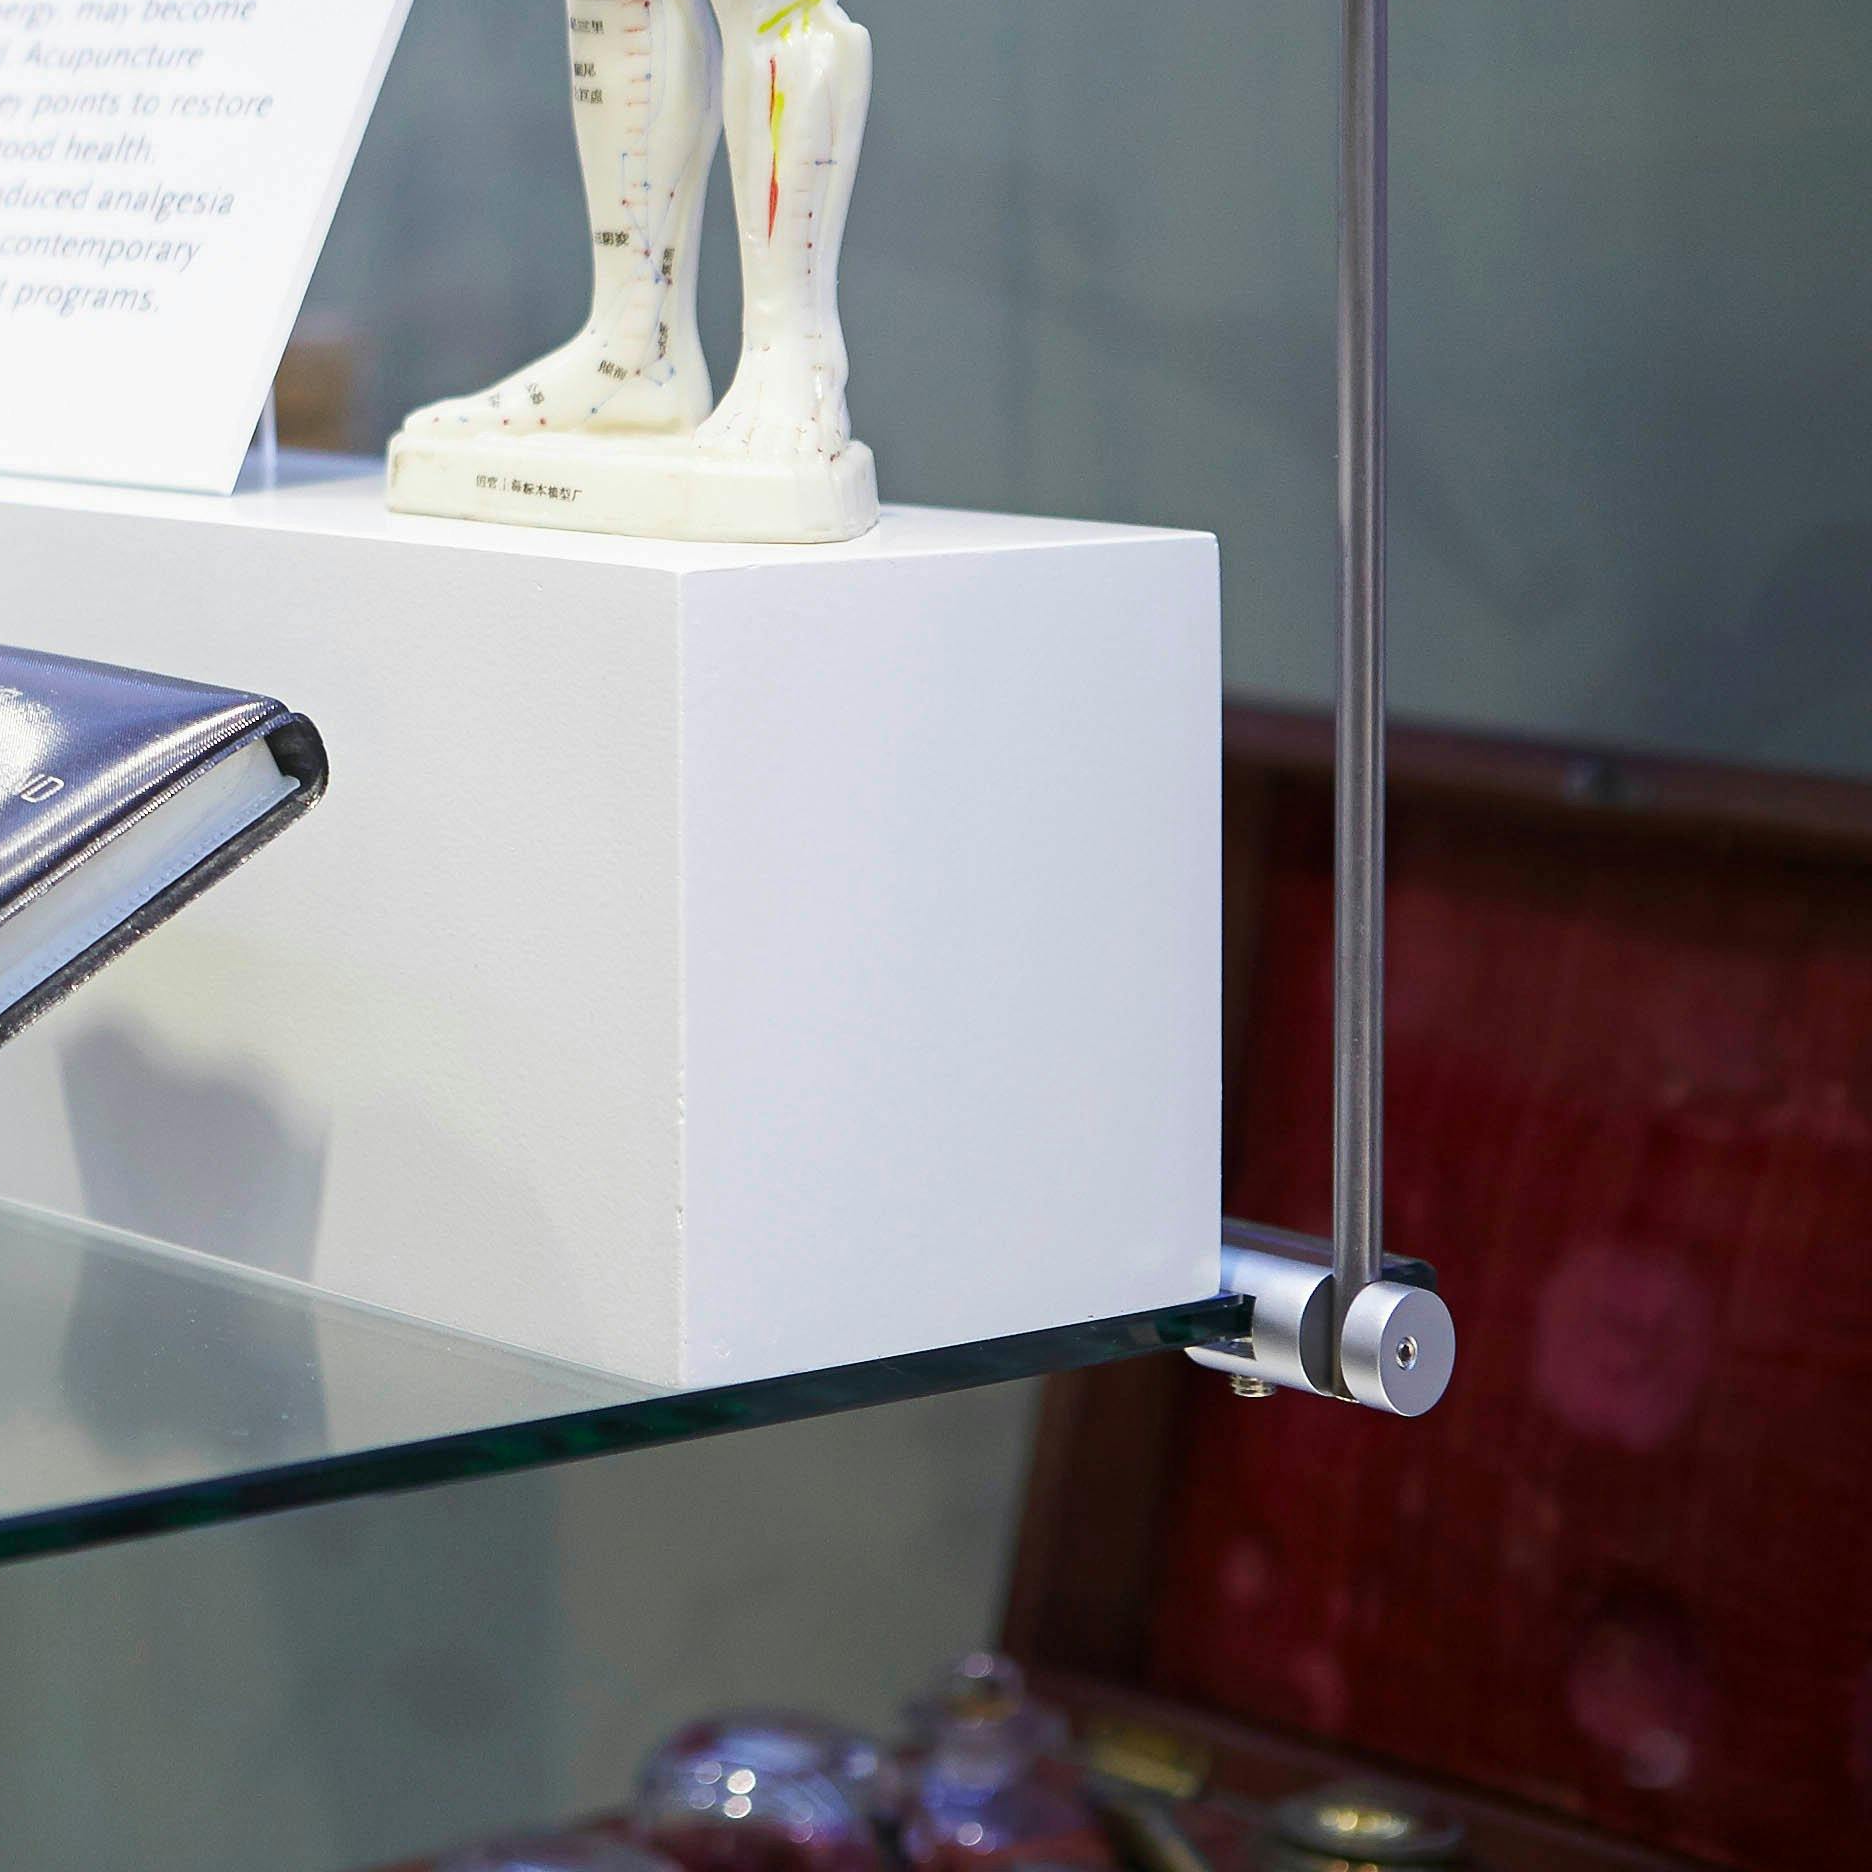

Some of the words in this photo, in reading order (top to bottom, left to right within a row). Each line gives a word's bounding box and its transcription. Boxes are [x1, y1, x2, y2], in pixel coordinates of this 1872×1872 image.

[76, 0, 132, 28] may
[24, 42, 204, 73] Acupuncture
[32, 87, 120, 120] points
[131, 90, 160, 115] to
[169, 90, 274, 119] restore
[98, 183, 235, 222] analgesia
[0, 232, 202, 273] contemporary
[13, 280, 161, 318] programs.
